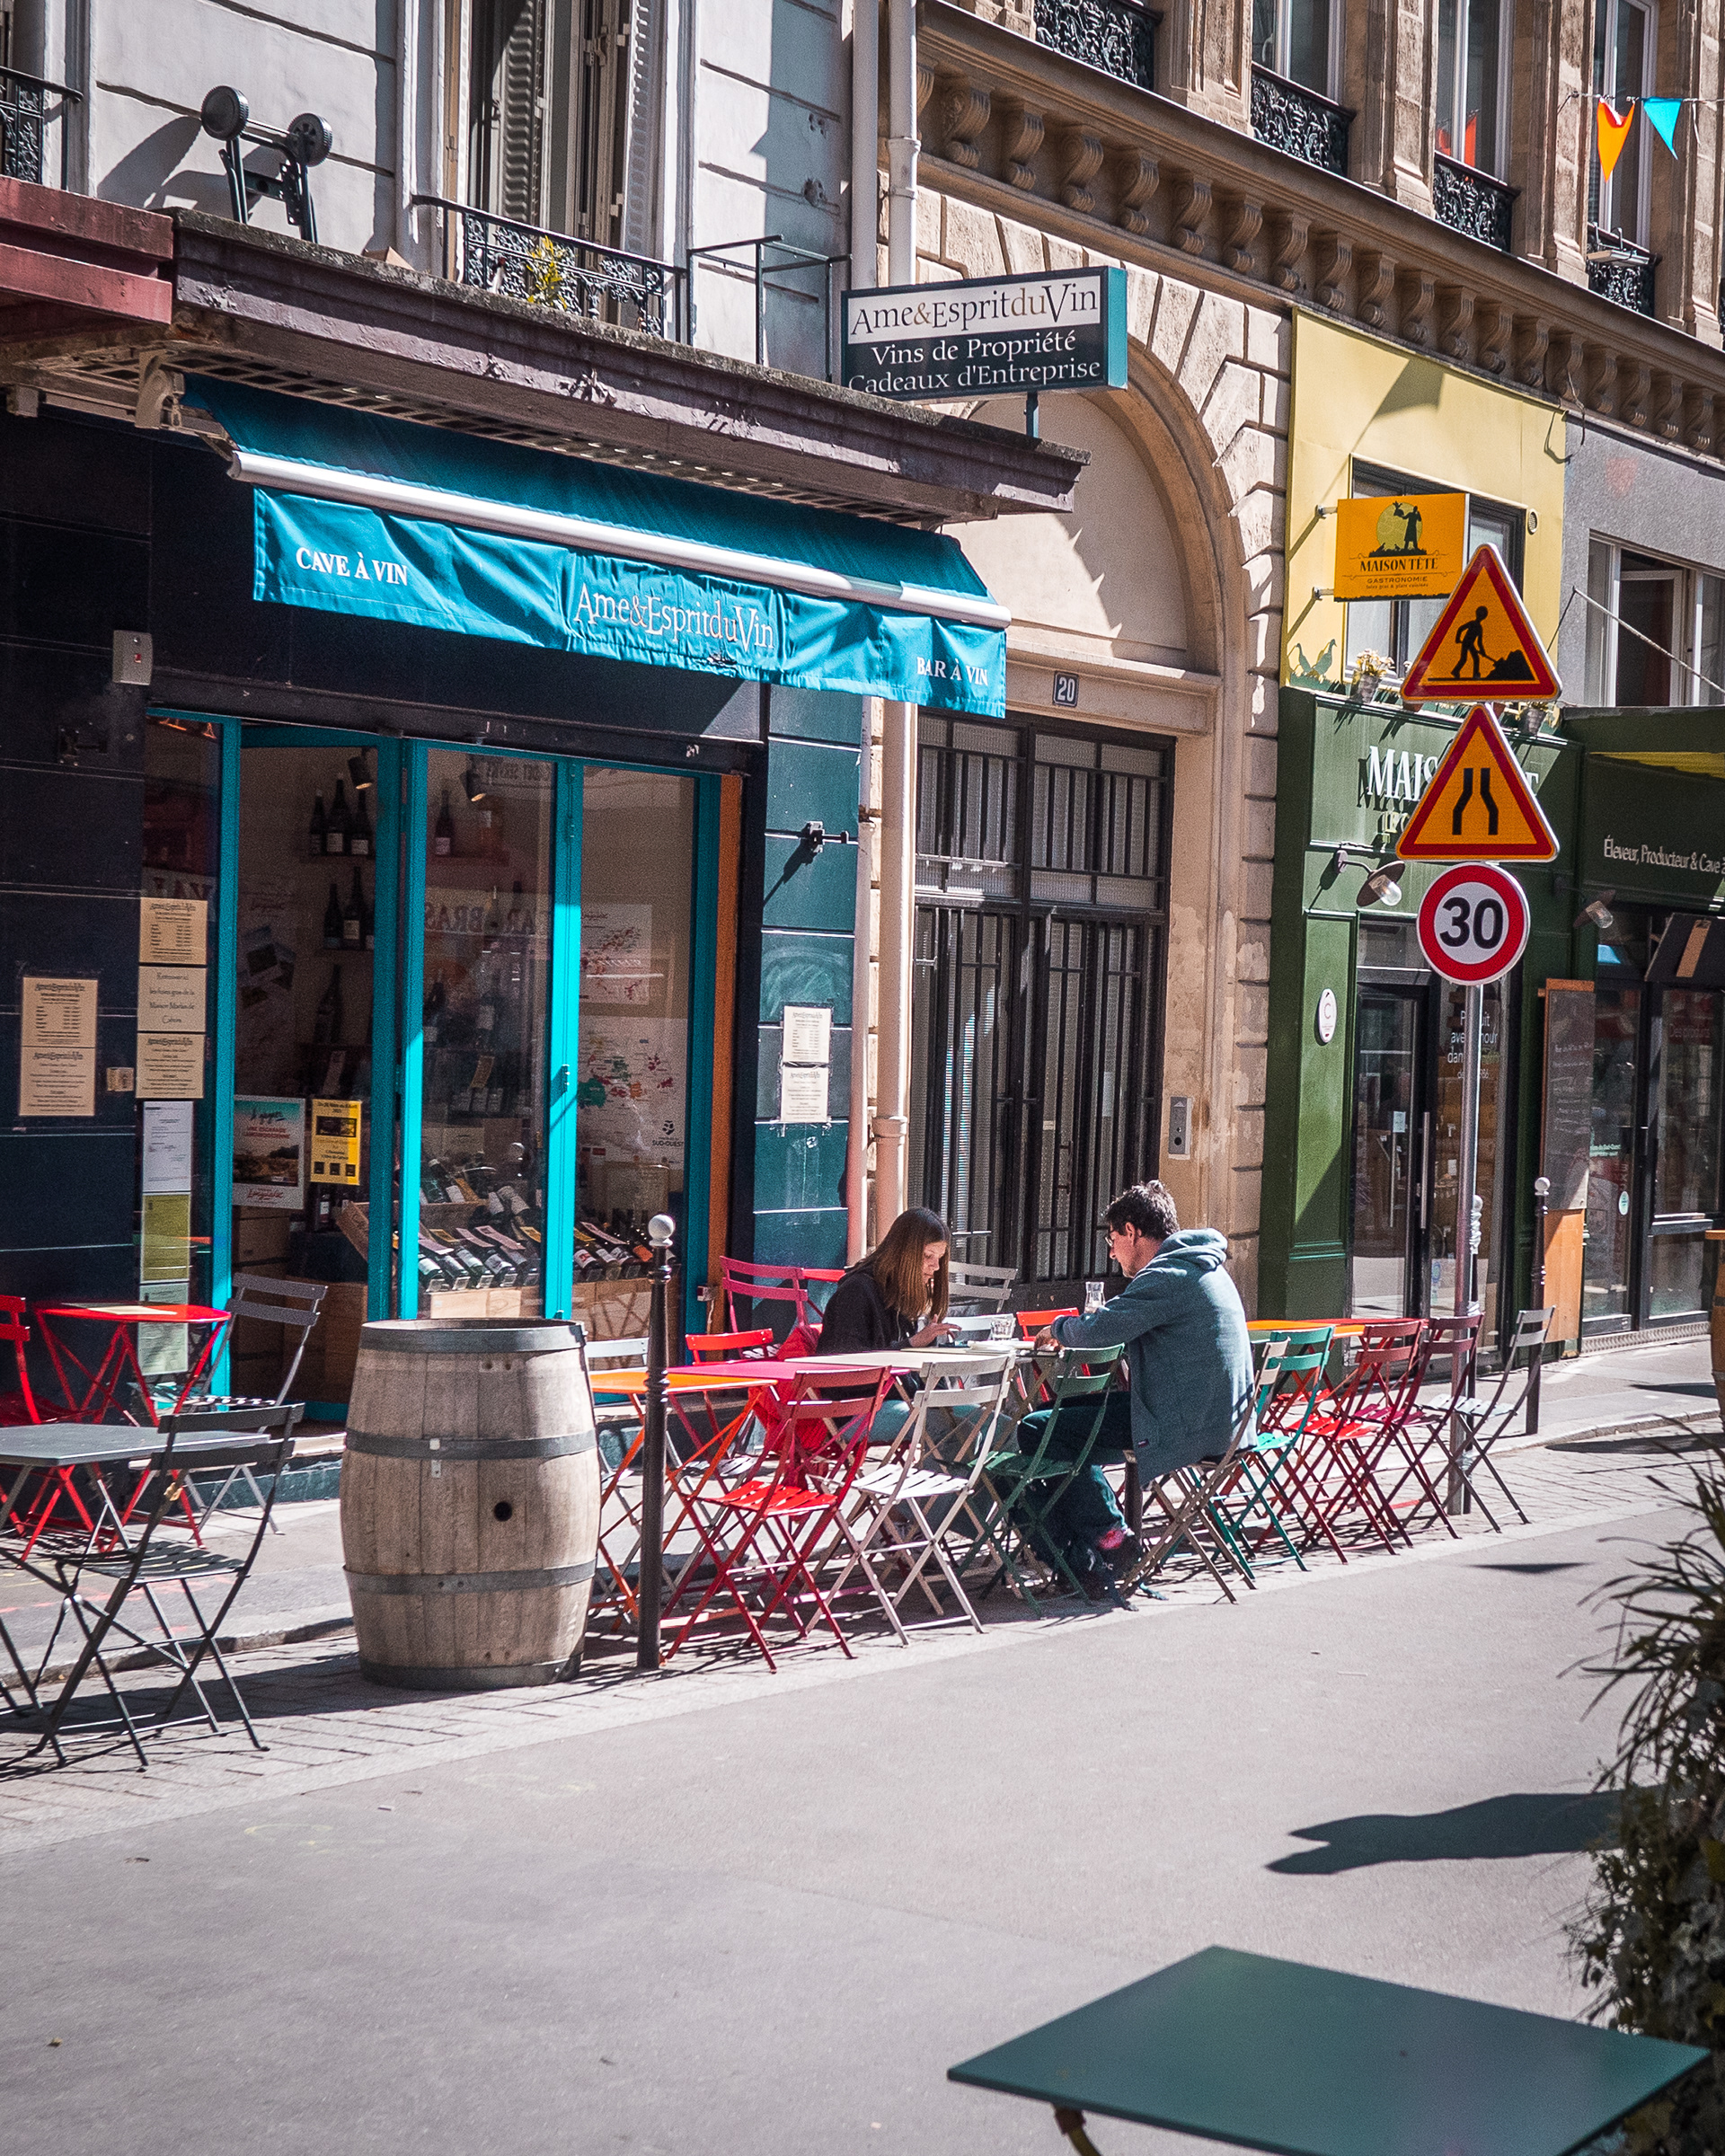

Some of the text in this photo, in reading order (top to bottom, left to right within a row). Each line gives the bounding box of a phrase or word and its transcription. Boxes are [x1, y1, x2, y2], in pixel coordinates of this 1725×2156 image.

[871, 330, 1075, 366] Vins de Propriété
[848, 358, 1101, 393] Cadeaux d'Entreprise
[296, 547, 408, 586] CAVE À VIN
[1359, 557, 1438, 571] MAISON TÊTE
[1367, 576, 1428, 584] GASTRONOMIE
[916, 657, 988, 686] BAR À VIN
[1057, 676, 1076, 702] 20
[1641, 844, 1690, 869] Producteur
[1690, 852, 1698, 870] &
[1699, 853, 1721, 874] Cave
[1439, 897, 1503, 949] 30
